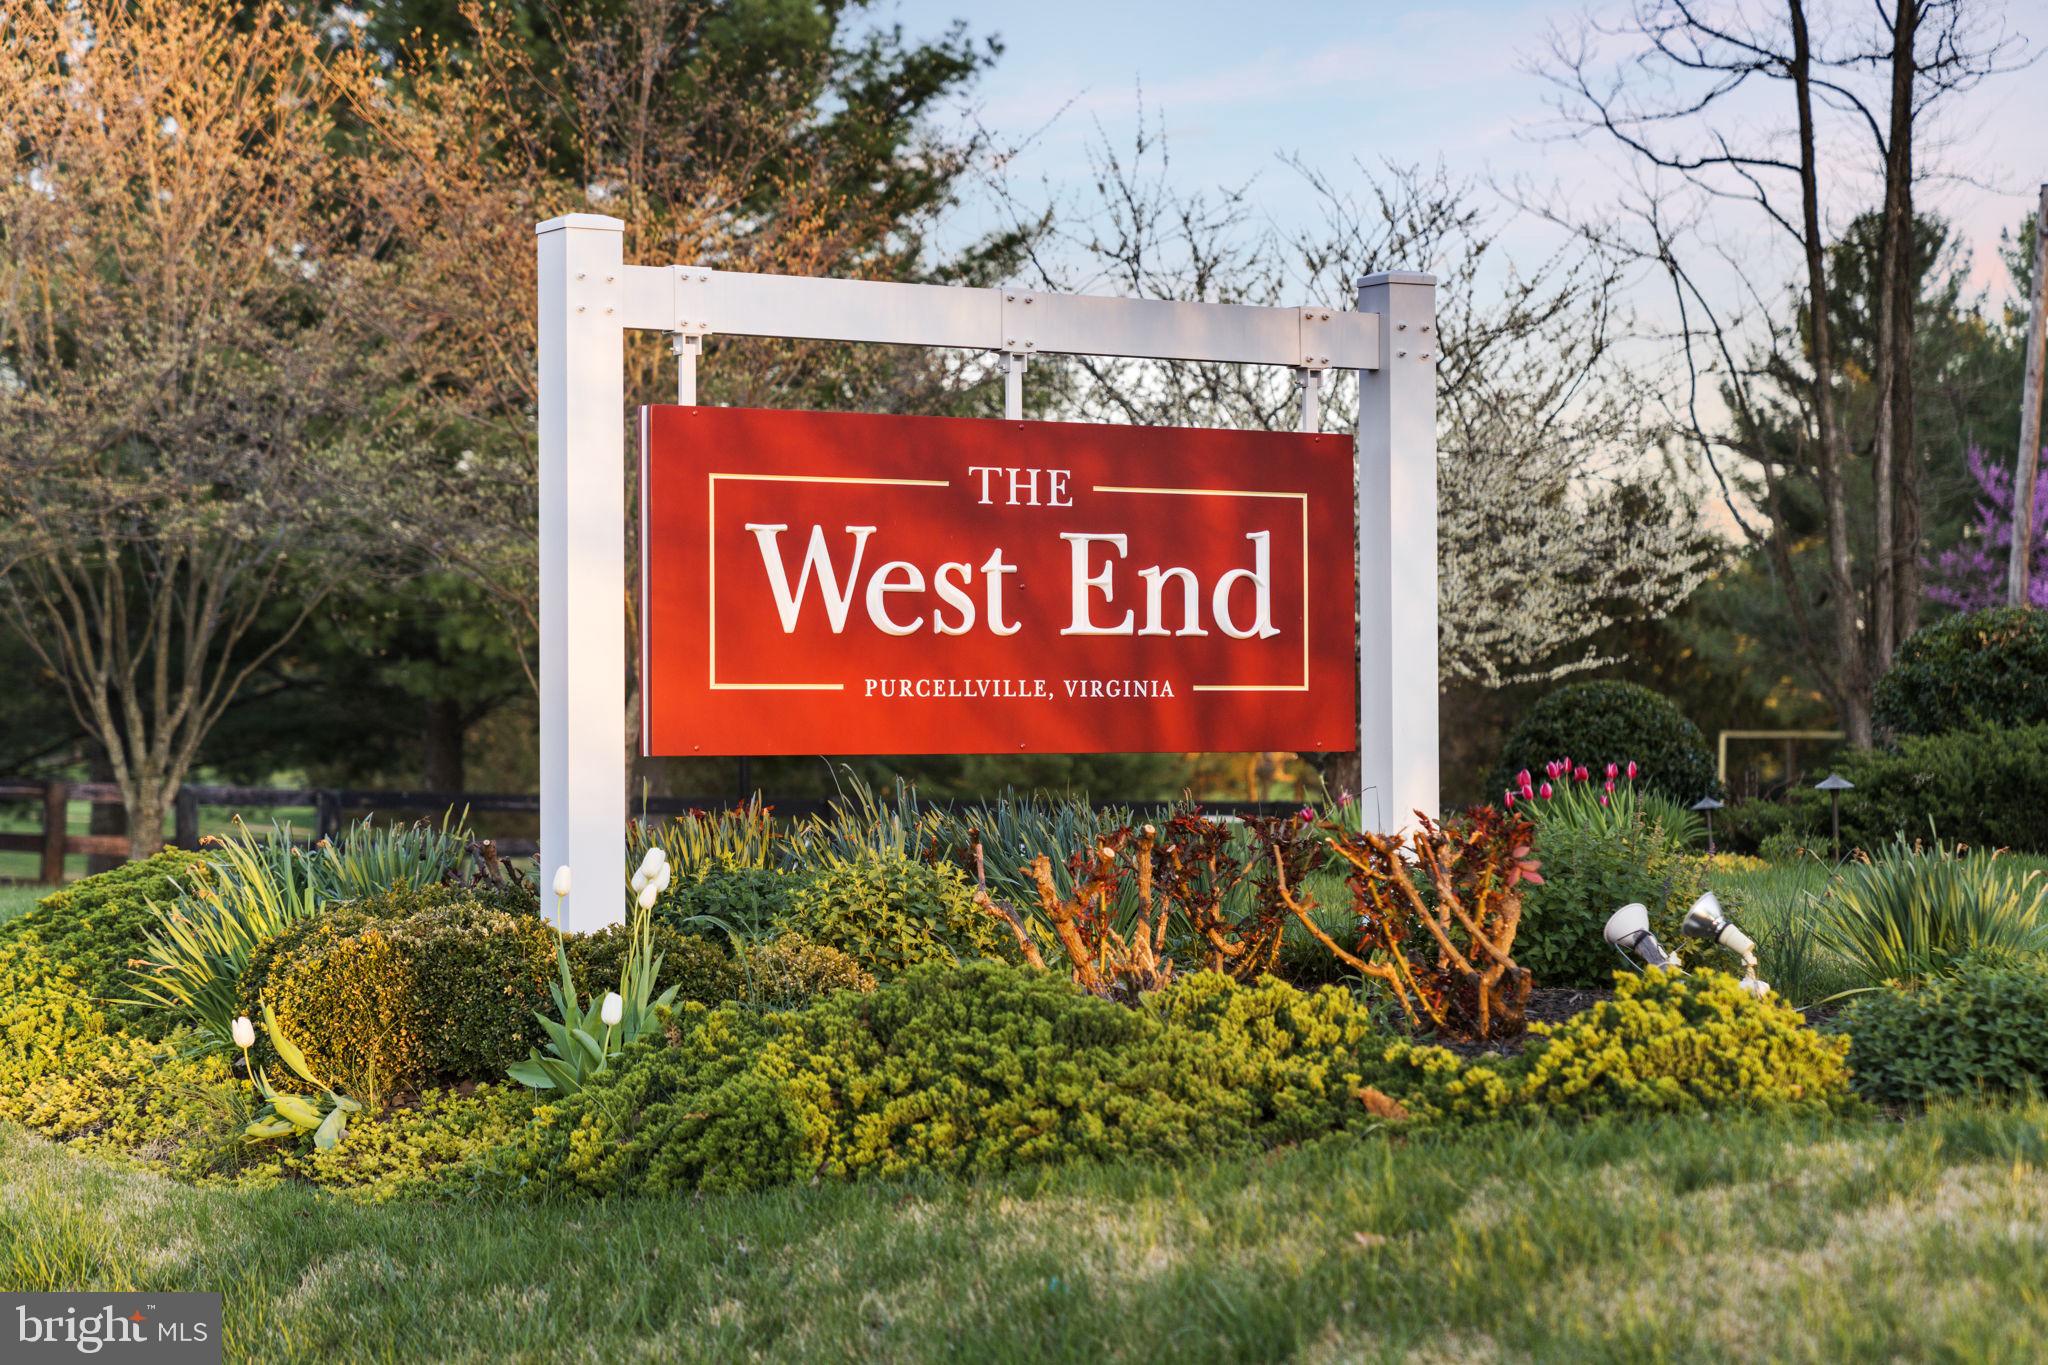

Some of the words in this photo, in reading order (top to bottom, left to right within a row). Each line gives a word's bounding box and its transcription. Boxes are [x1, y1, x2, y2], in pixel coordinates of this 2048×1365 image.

[968, 465, 1074, 507] THE
[744, 522, 1022, 636] West
[1059, 529, 1281, 640] End
[864, 678, 1054, 700] PURCELLVILLE,
[1063, 679, 1175, 698] VIRGINIA
